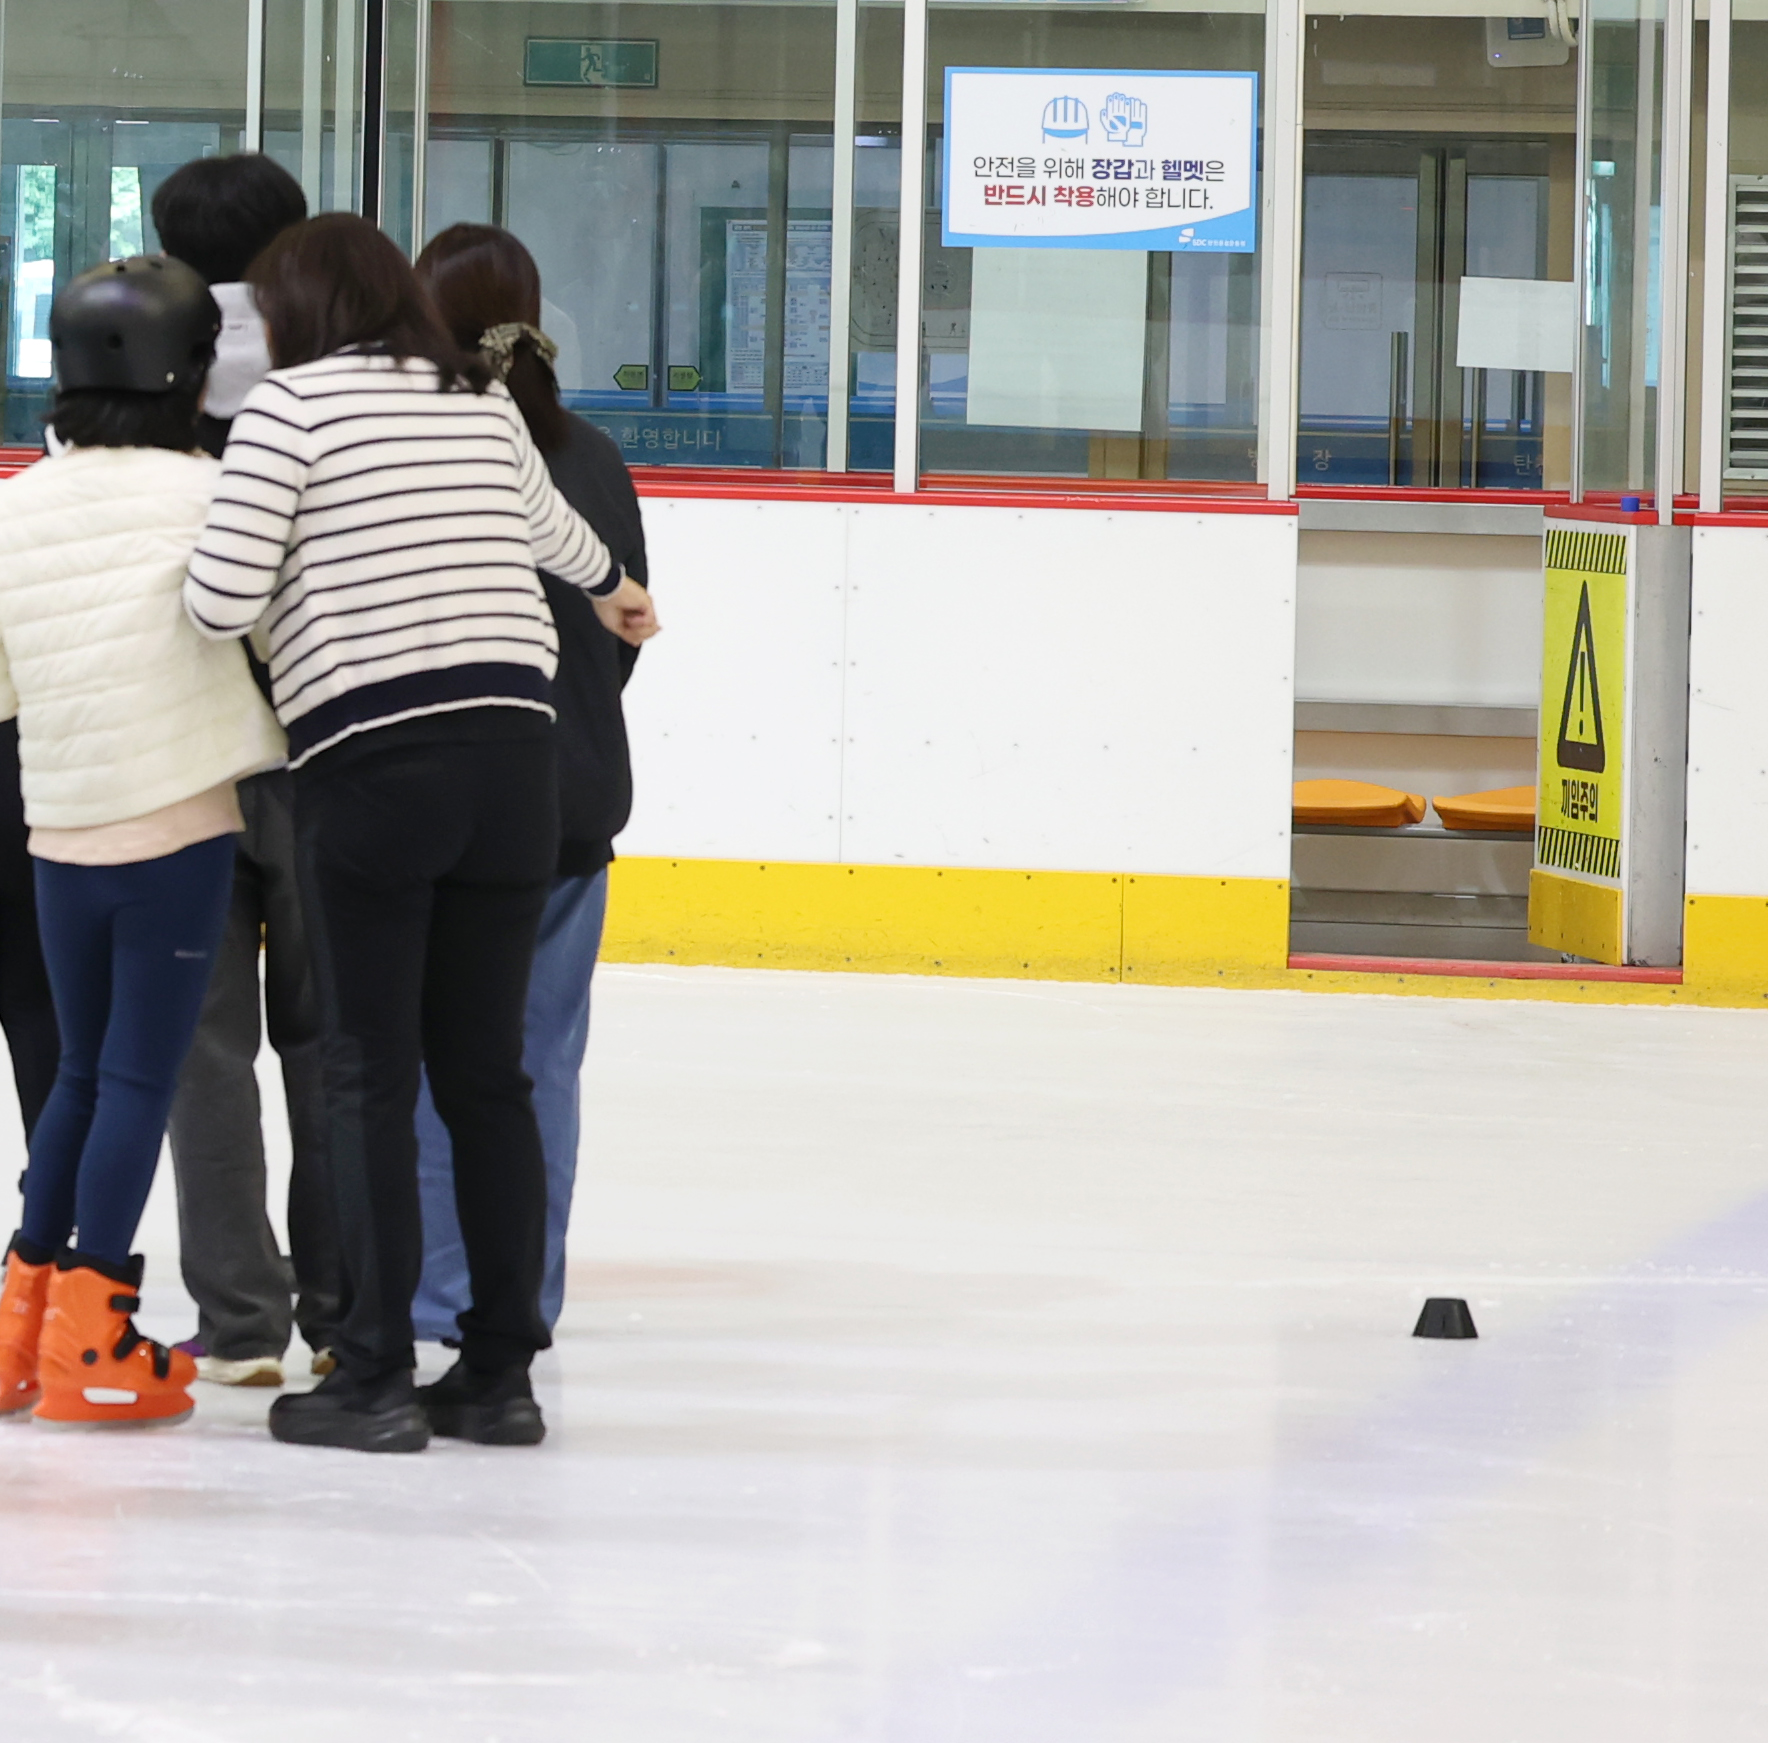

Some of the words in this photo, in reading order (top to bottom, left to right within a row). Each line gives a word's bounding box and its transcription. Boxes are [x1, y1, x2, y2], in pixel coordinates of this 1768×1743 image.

[973, 156, 1037, 180] 안전을
[1042, 156, 1085, 180] 위해
[1091, 158, 1156, 182] 장갑과
[1161, 159, 1226, 183] 헬멧은
[983, 184, 1047, 208] 반드시
[1053, 185, 1140, 209] 착용해야
[1145, 187, 1214, 210] 합니다.
[621, 426, 722, 451] 환영합니다
[1560, 778, 1599, 824] 끼임주의
